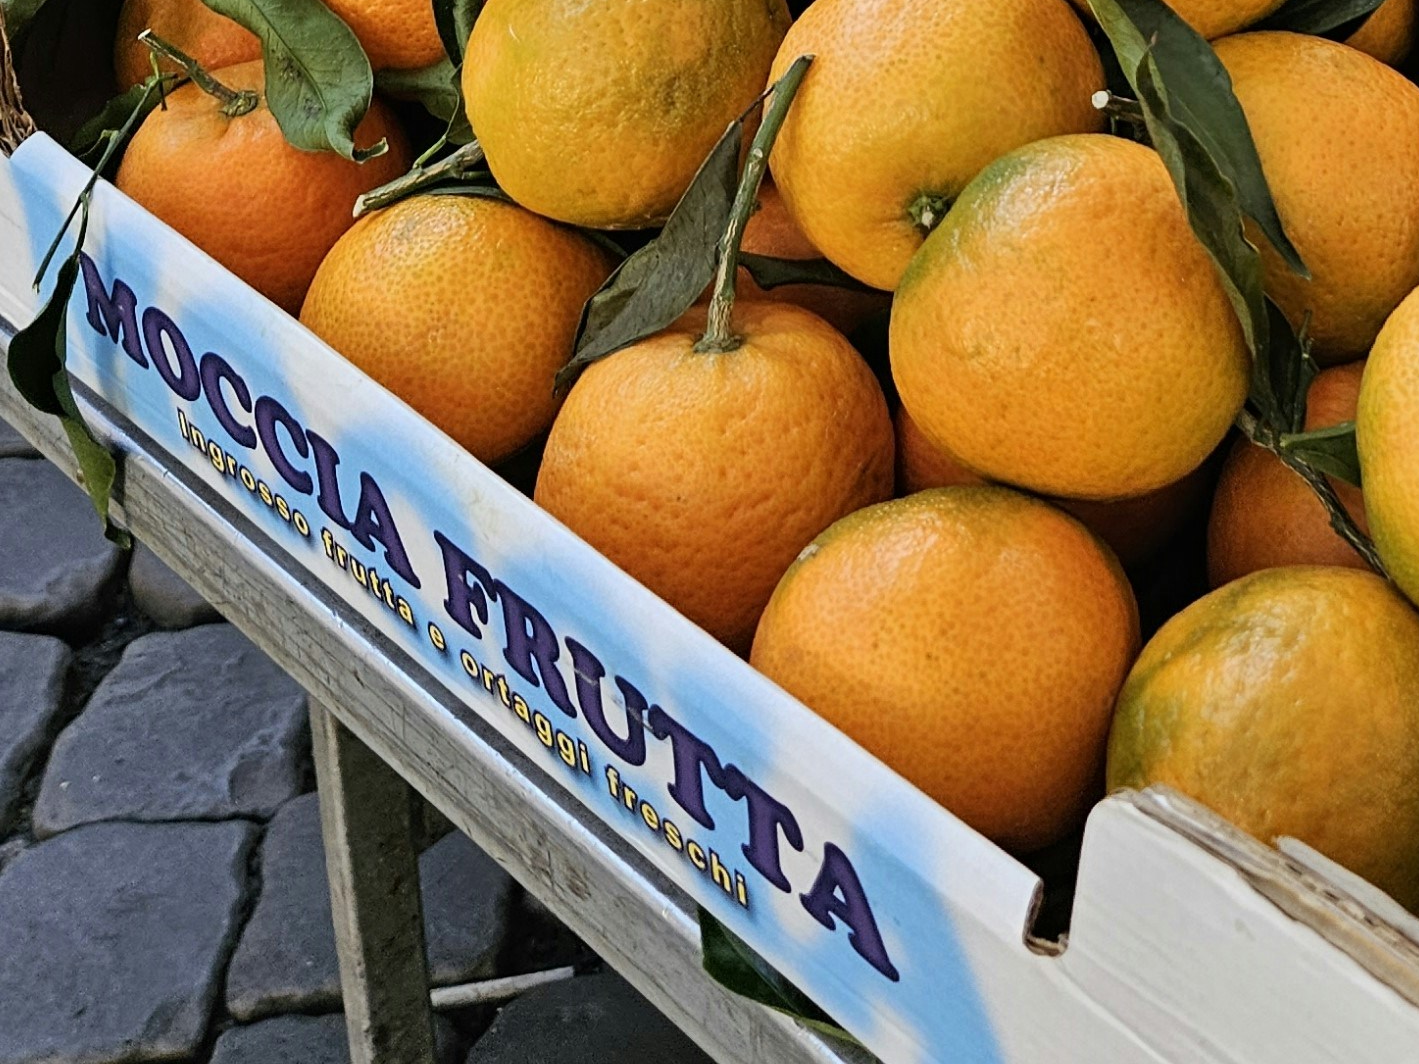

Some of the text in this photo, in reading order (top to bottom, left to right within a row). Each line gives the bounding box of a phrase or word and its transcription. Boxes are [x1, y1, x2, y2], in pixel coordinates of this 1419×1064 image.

[80, 251, 900, 982] MOCCIA FRUTTA
[177, 407, 750, 910] Ingrosso frutta e ortaggi freschi
